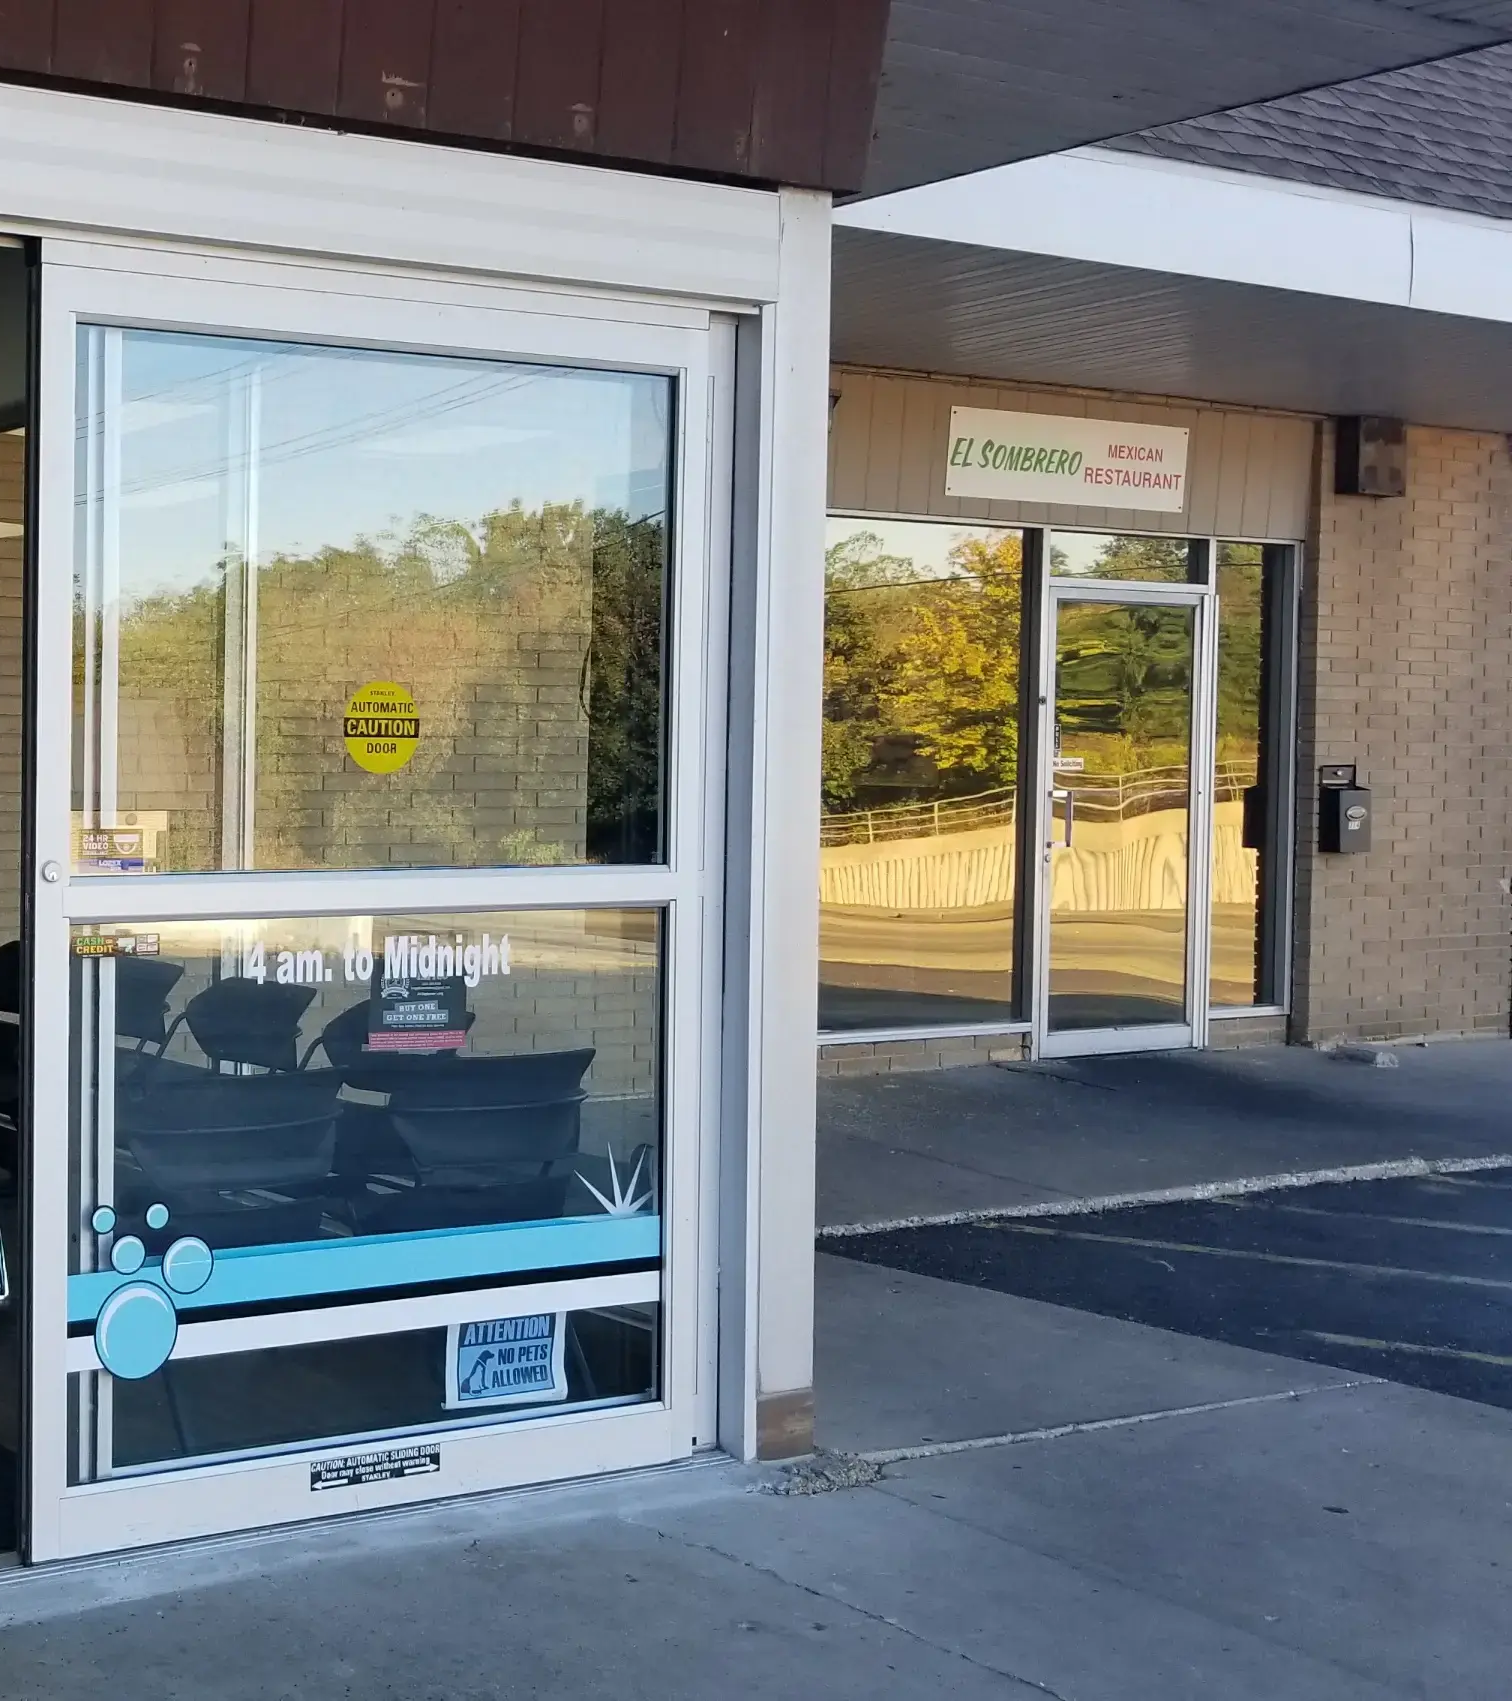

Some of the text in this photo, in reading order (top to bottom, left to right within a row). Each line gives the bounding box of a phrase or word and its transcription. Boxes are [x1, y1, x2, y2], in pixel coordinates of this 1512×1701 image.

[950, 437, 1083, 476] EL SOMBRERO
[1108, 444, 1164, 463] MEXICAN
[1084, 467, 1182, 491] RESTAURANT
[351, 701, 414, 714] AUTOMATIC
[347, 719, 415, 736] CAUTION
[367, 742, 397, 754] DOOR
[82, 834, 108, 843] 24 HR
[82, 842, 109, 850] VIDEO
[76, 937, 104, 946] CASH
[76, 946, 114, 954] CREDIT
[247, 941, 266, 984] 4
[276, 950, 332, 984] am.
[344, 941, 374, 981] to
[384, 934, 511, 987] Midnight
[399, 1003, 436, 1013] BUY ONE
[464, 1315, 550, 1346] ATTENTION
[498, 1344, 548, 1366] NO PETS
[492, 1364, 548, 1389] ALLOWED
[311, 1444, 440, 1473] CAUTION: AUTOMATIC SLIDING DOOR
[322, 1456, 430, 1480] Door may close without warning
[361, 1471, 391, 1482] STANLEY
